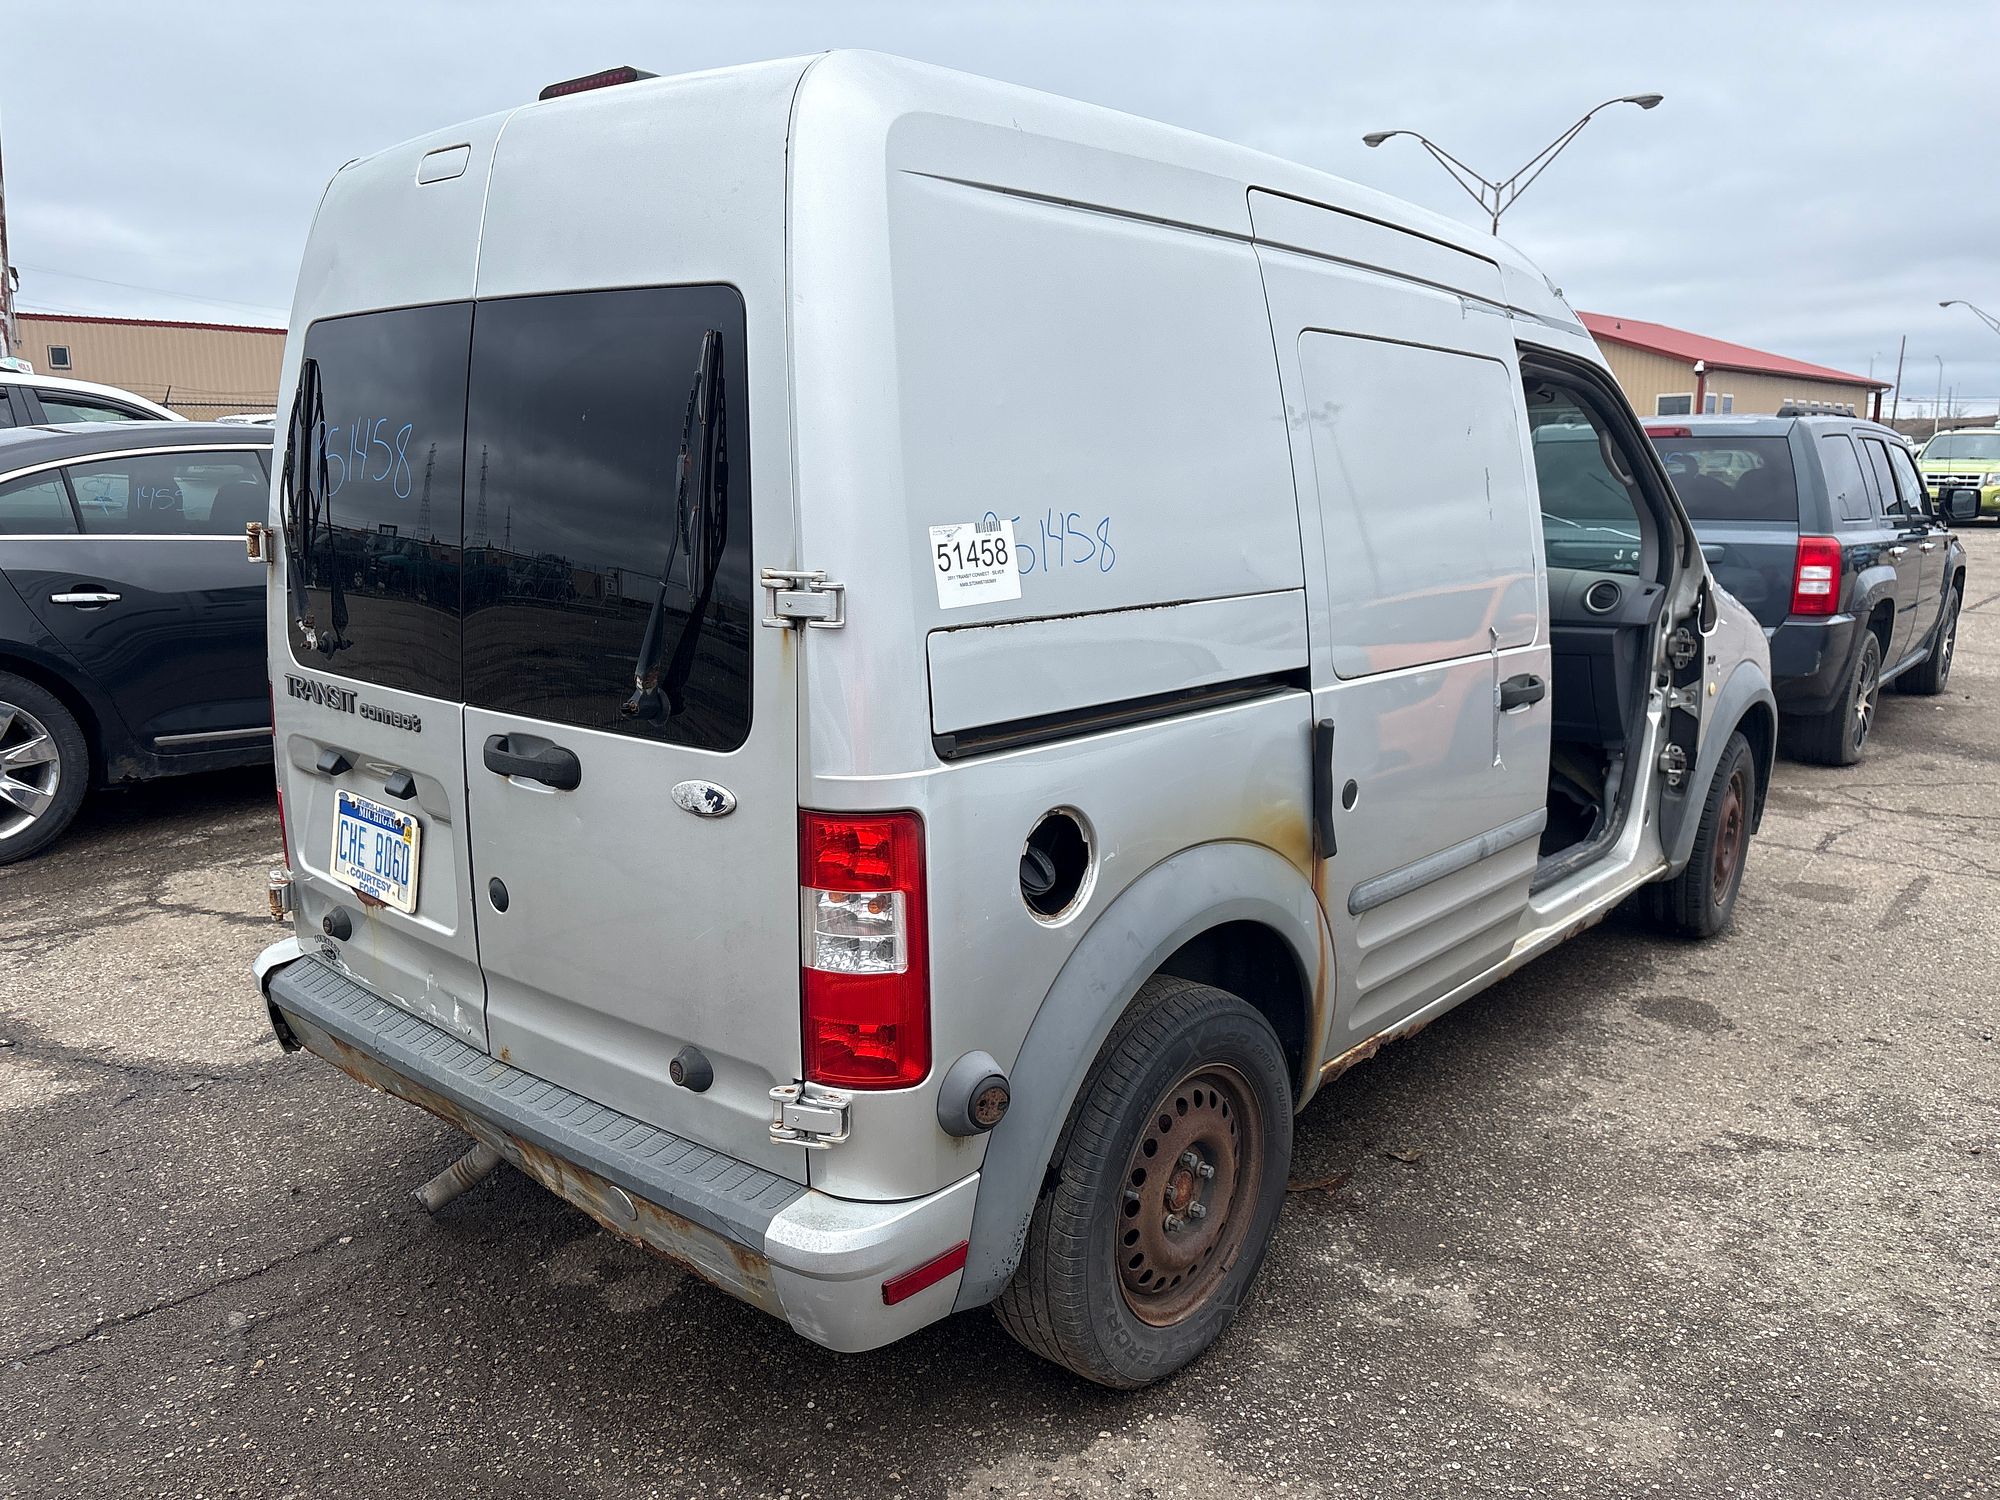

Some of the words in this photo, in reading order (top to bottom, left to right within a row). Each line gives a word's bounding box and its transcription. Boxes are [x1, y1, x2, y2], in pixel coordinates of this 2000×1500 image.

[937, 537, 1008, 572] 51458
[284, 673, 358, 714] TRANSIT
[360, 702, 422, 733] connect
[339, 819, 367, 868] CHE
[375, 831, 410, 886] 8060
[350, 866, 391, 894] COURTESY
[359, 881, 380, 899] FORD
